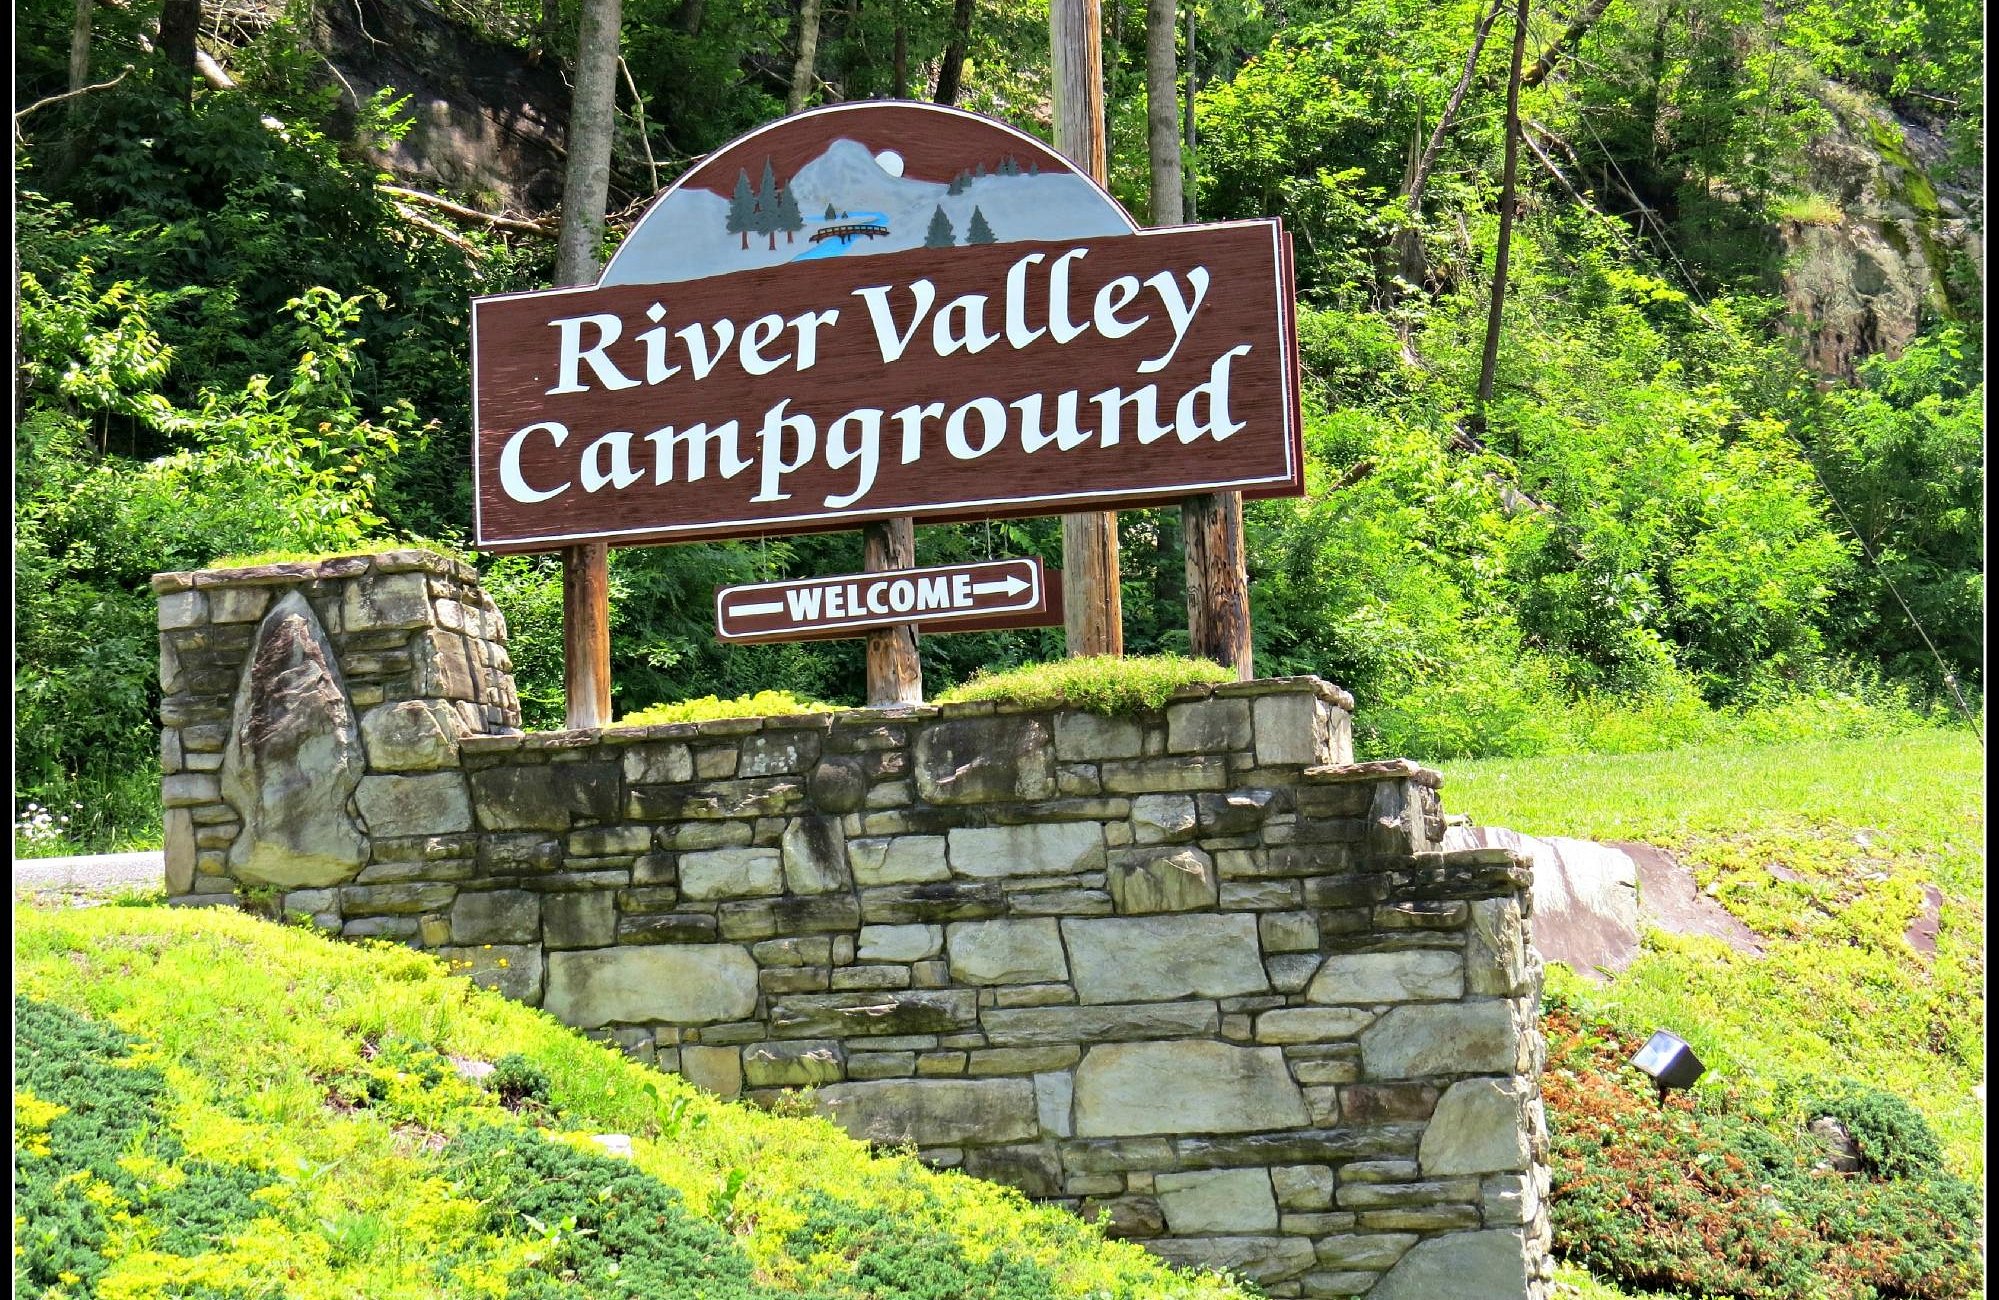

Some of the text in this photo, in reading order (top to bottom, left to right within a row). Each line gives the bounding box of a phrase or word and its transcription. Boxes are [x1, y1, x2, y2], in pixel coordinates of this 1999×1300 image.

[544, 247, 1211, 397] River Valley
[498, 344, 1253, 510] Campground
[784, 572, 976, 622] WELCOME
